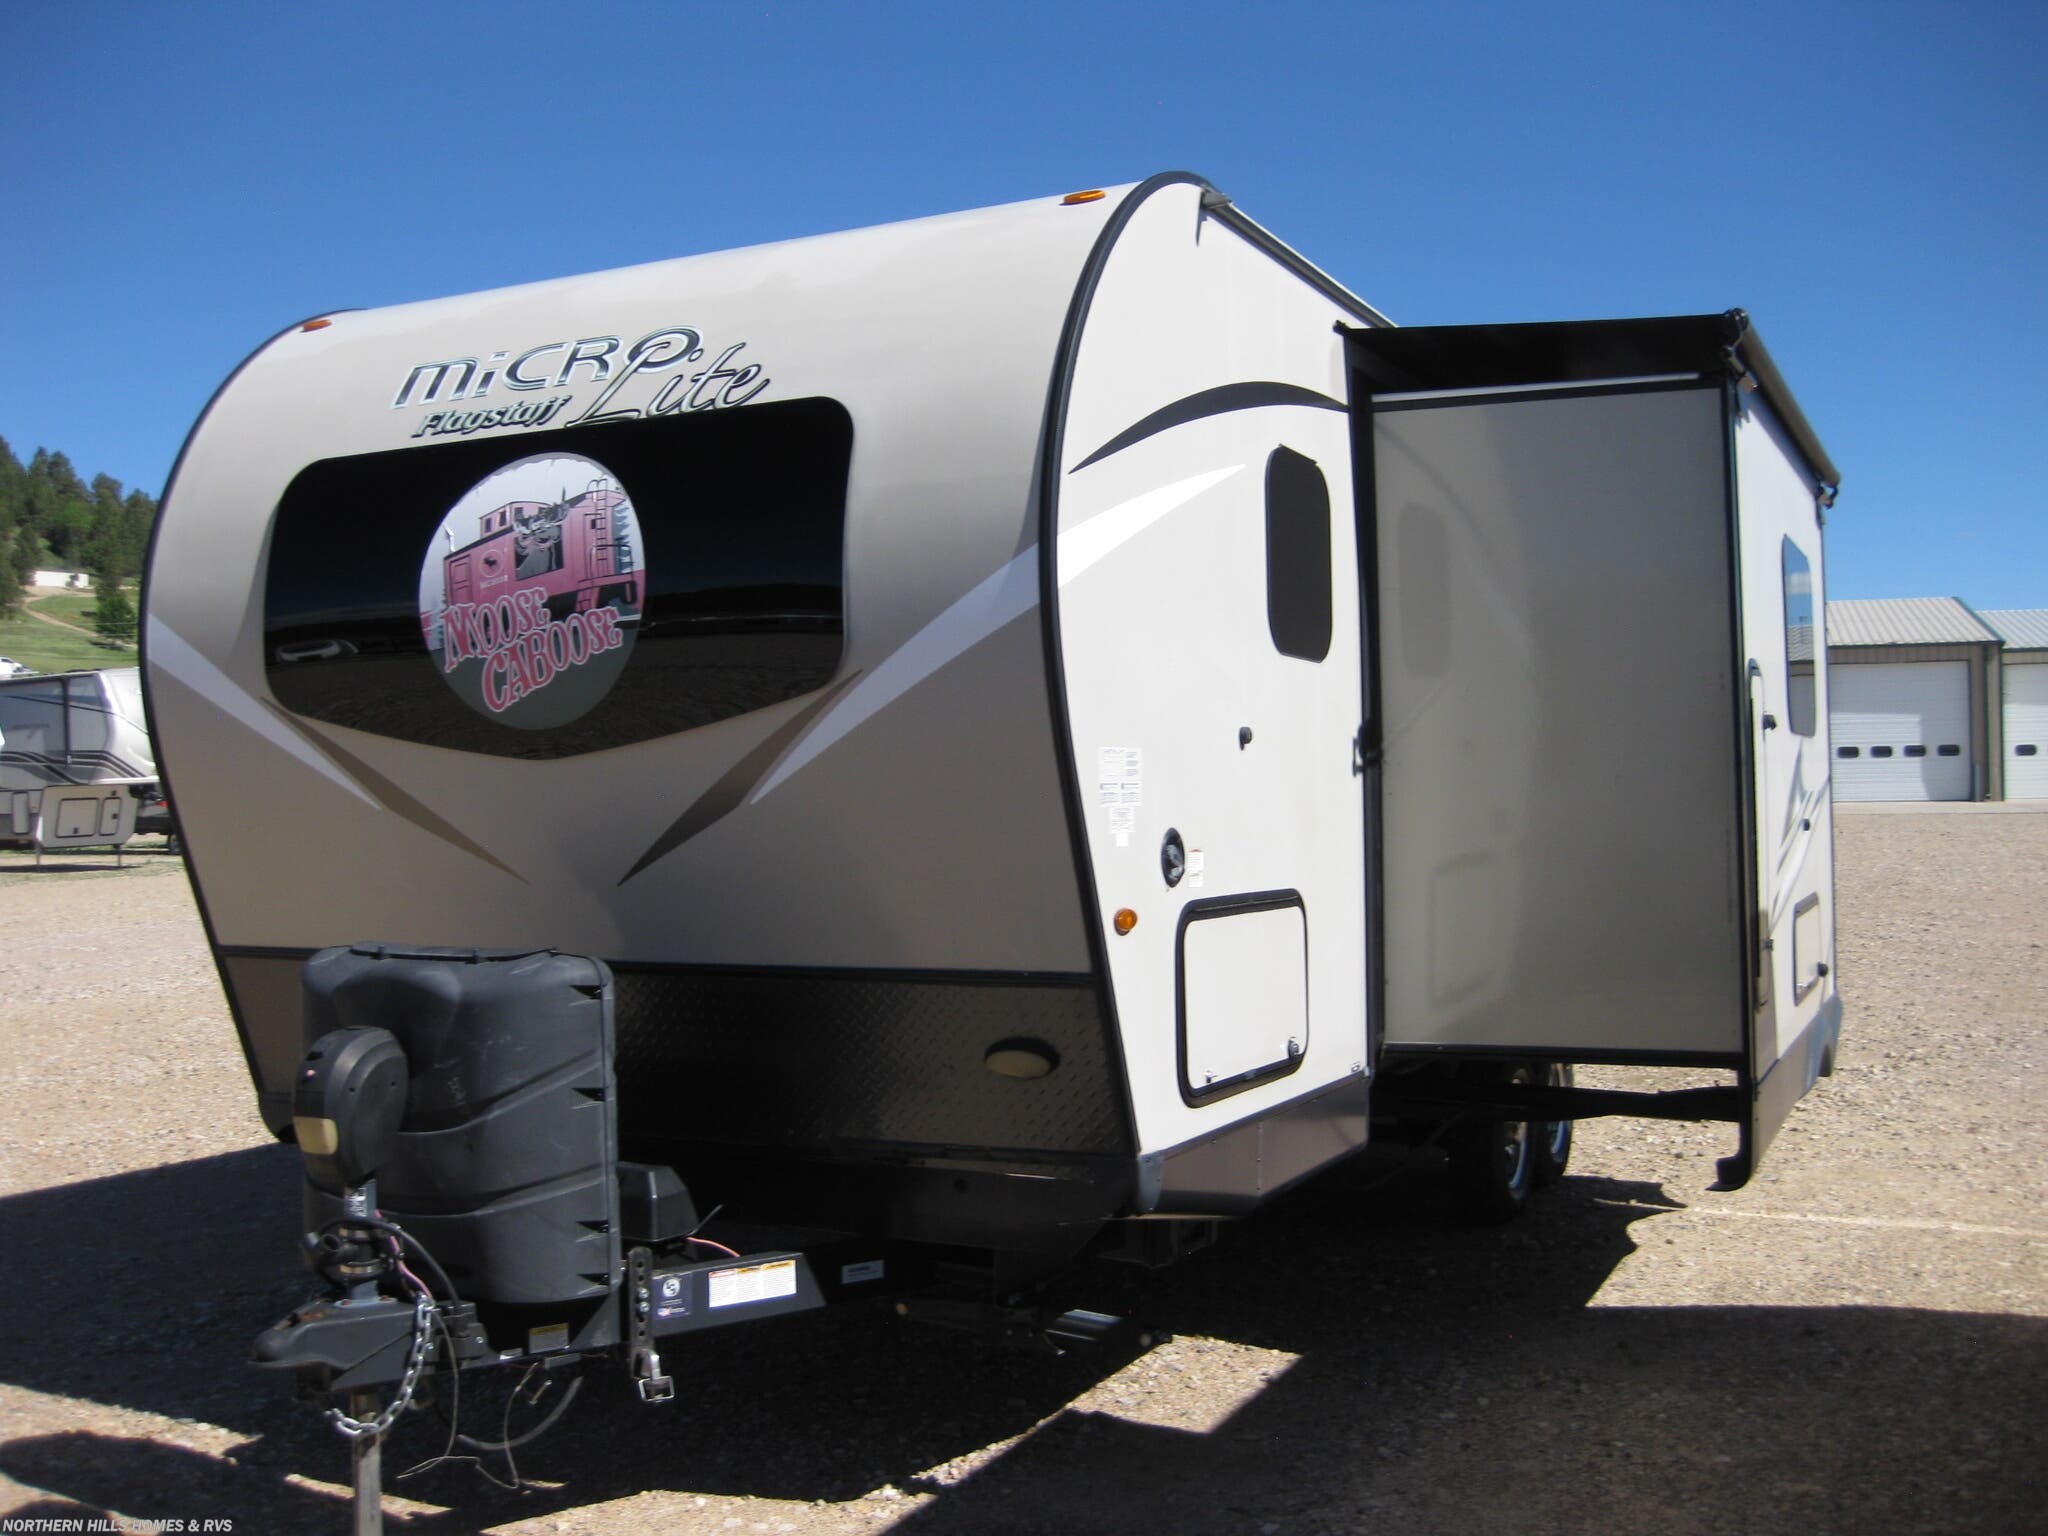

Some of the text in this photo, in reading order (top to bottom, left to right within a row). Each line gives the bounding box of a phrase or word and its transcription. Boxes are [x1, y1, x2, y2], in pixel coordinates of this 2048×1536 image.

[411, 396, 572, 438] Flagstaff
[565, 341, 770, 428] Lite
[439, 587, 550, 673] MOOSE
[482, 606, 623, 712] CABOOSE
